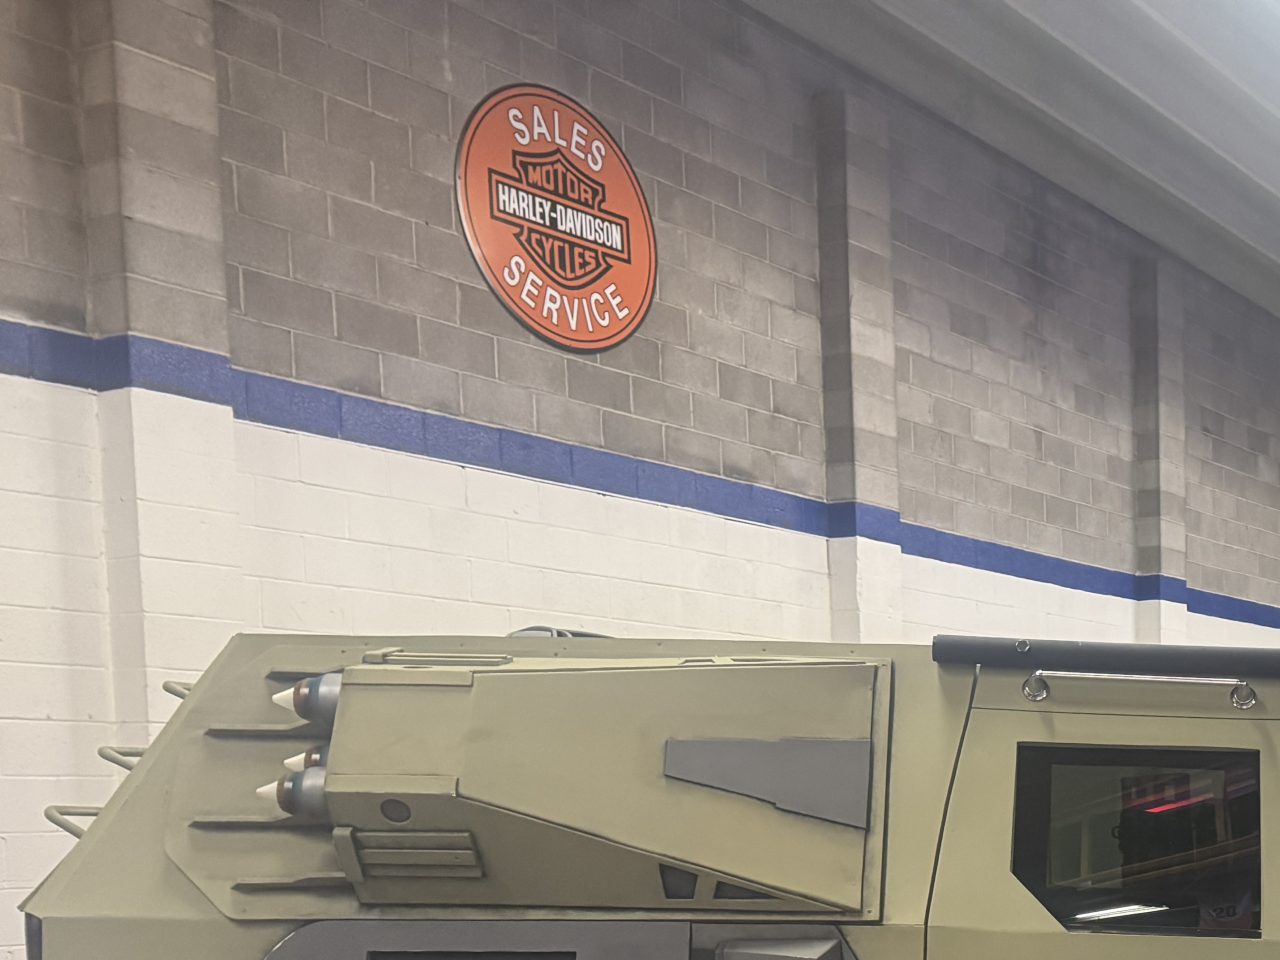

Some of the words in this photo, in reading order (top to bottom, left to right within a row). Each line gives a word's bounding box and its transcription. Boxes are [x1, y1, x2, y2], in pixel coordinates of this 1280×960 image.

[507, 105, 606, 172] SALES
[498, 183, 623, 251] HARLEY-DAVIDSON
[528, 163, 593, 206] MOTOR
[530, 228, 598, 279] CYCLES
[504, 255, 630, 332] SERVICE
